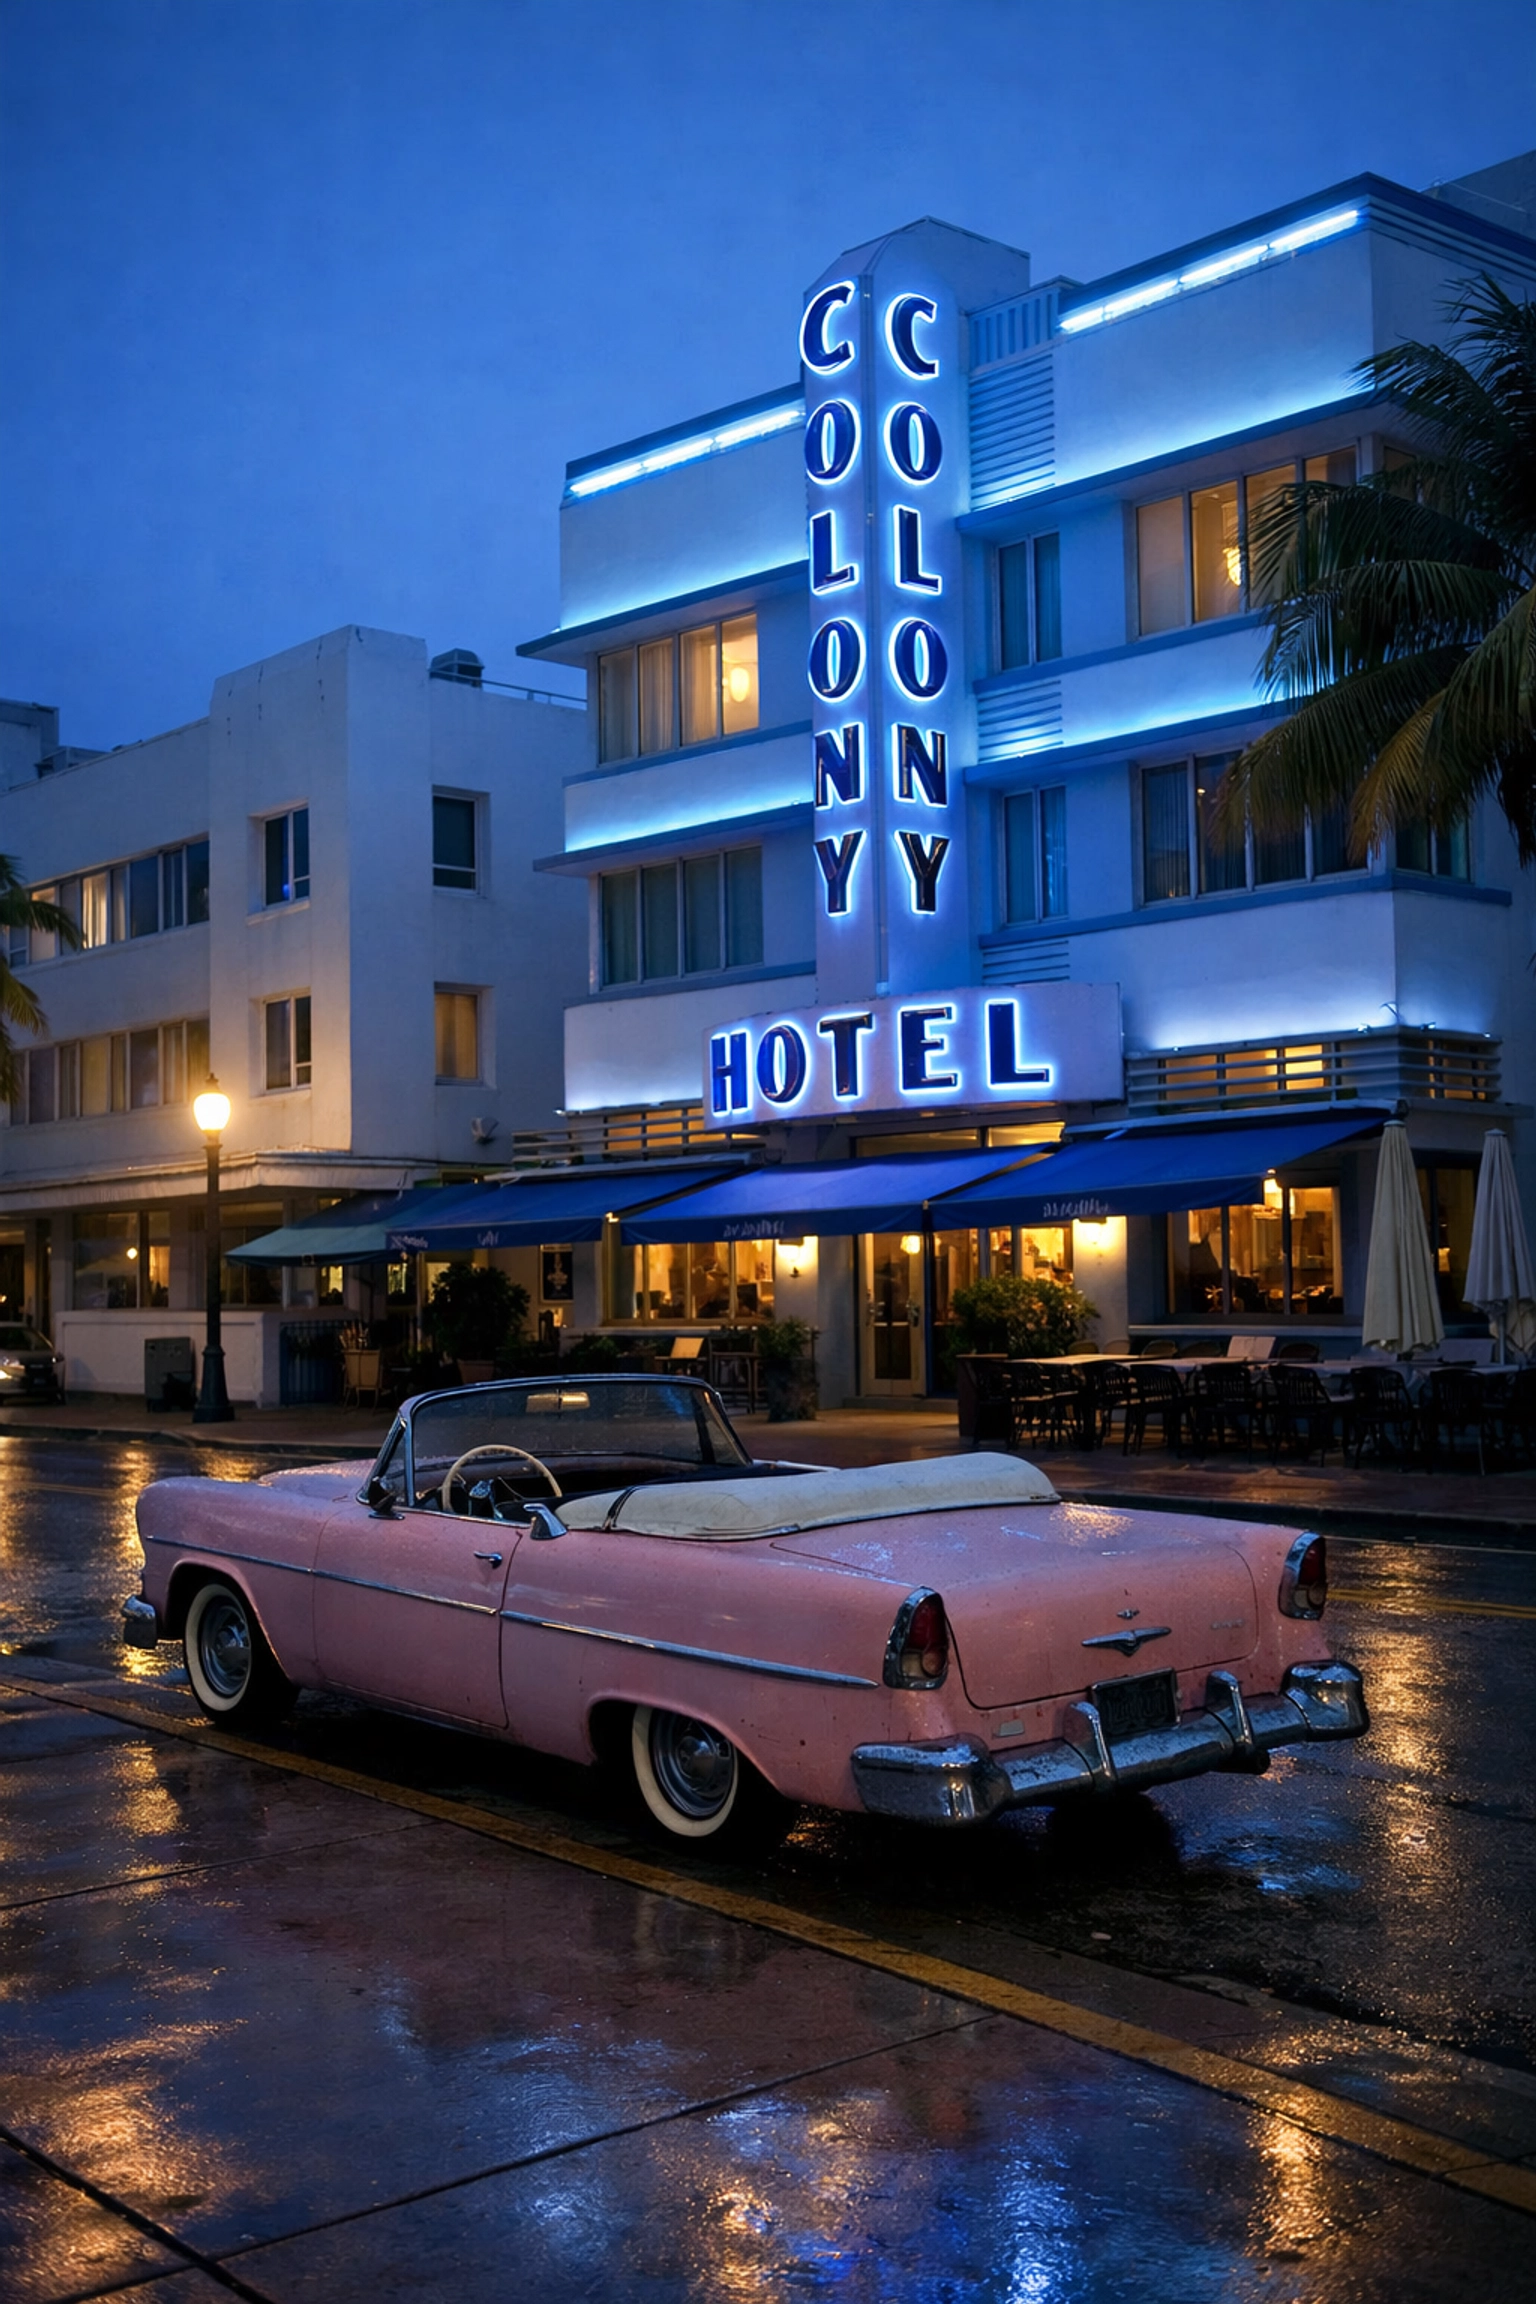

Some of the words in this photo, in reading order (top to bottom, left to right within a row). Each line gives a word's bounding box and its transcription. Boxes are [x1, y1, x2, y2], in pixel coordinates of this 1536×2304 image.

[801, 281, 866, 916] COLONY
[886, 294, 950, 914] COLONY
[710, 1000, 1053, 1116] HOTEL
